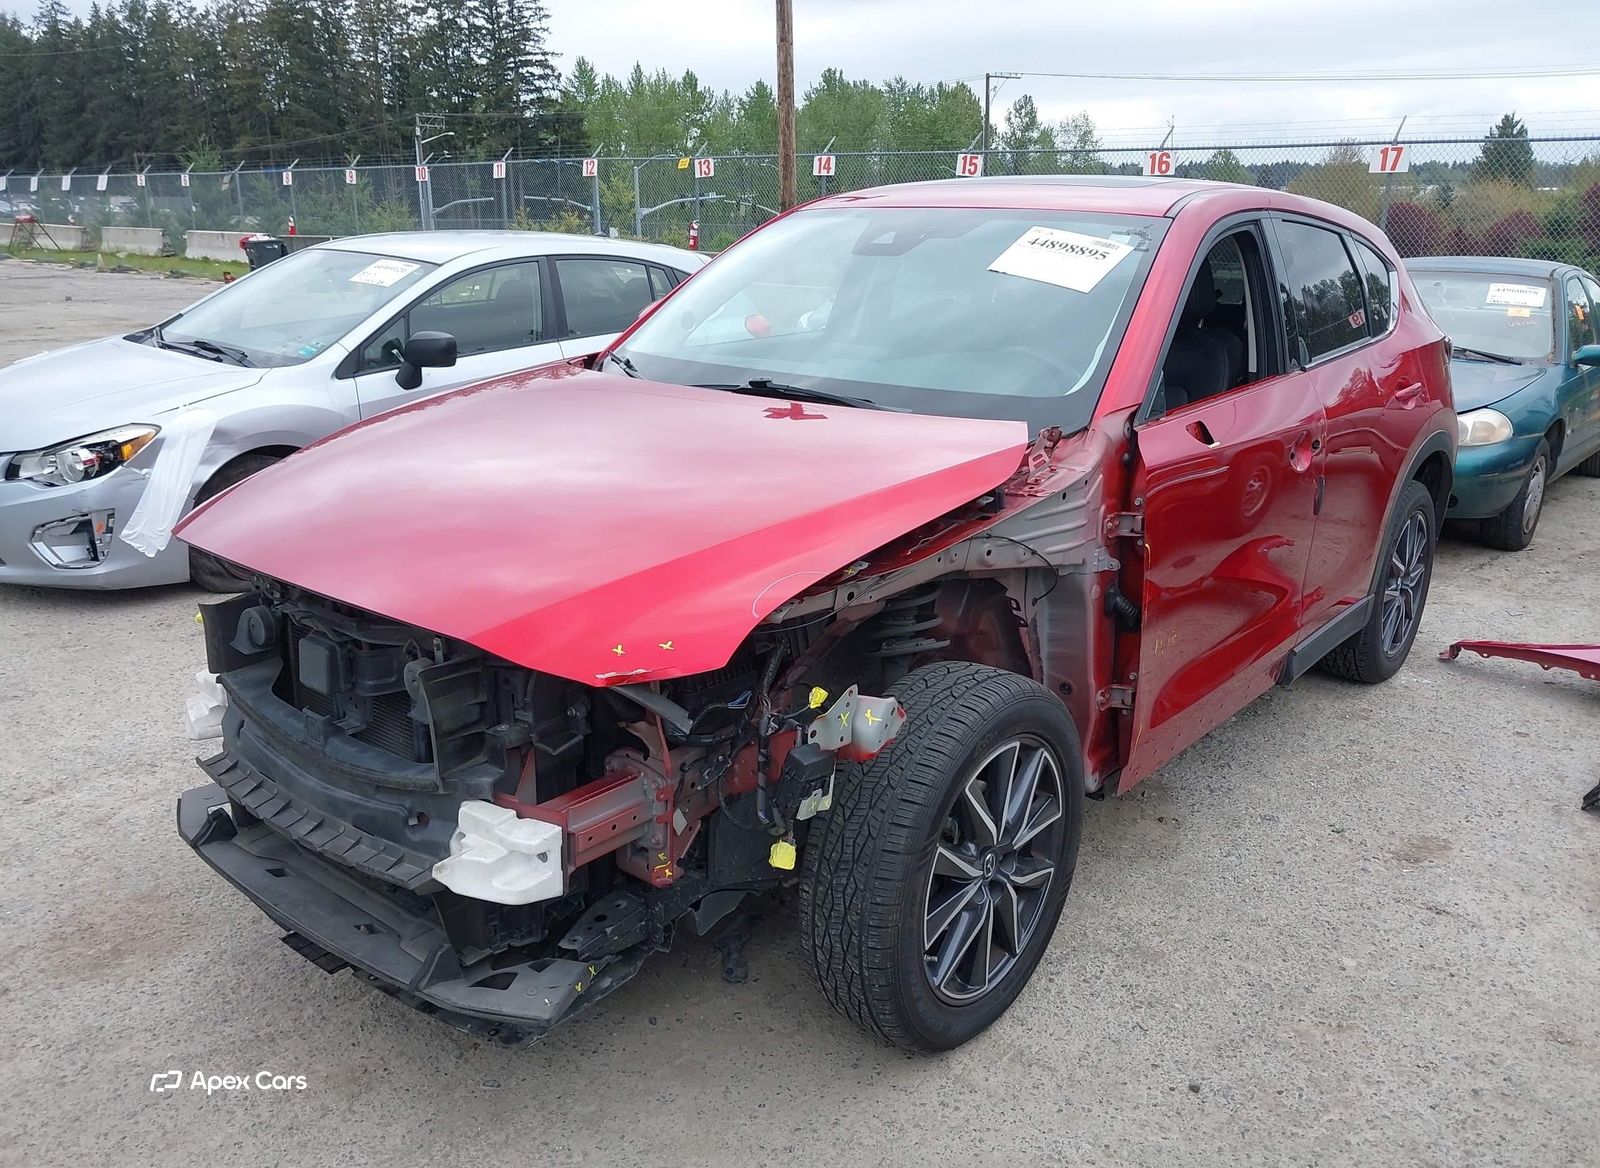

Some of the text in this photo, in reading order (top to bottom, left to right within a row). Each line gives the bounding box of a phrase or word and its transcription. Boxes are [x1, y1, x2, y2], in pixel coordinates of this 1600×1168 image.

[585, 160, 595, 176] 12
[697, 158, 711, 176] 13
[817, 155, 832, 174] 14
[961, 155, 979, 175] 15
[1149, 151, 1171, 175] 16
[1380, 146, 1404, 172] 17
[347, 170, 355, 183] 9
[417, 167, 427, 181] 10
[495, 163, 504, 178] 11
[1028, 238, 1110, 260] 44898895
